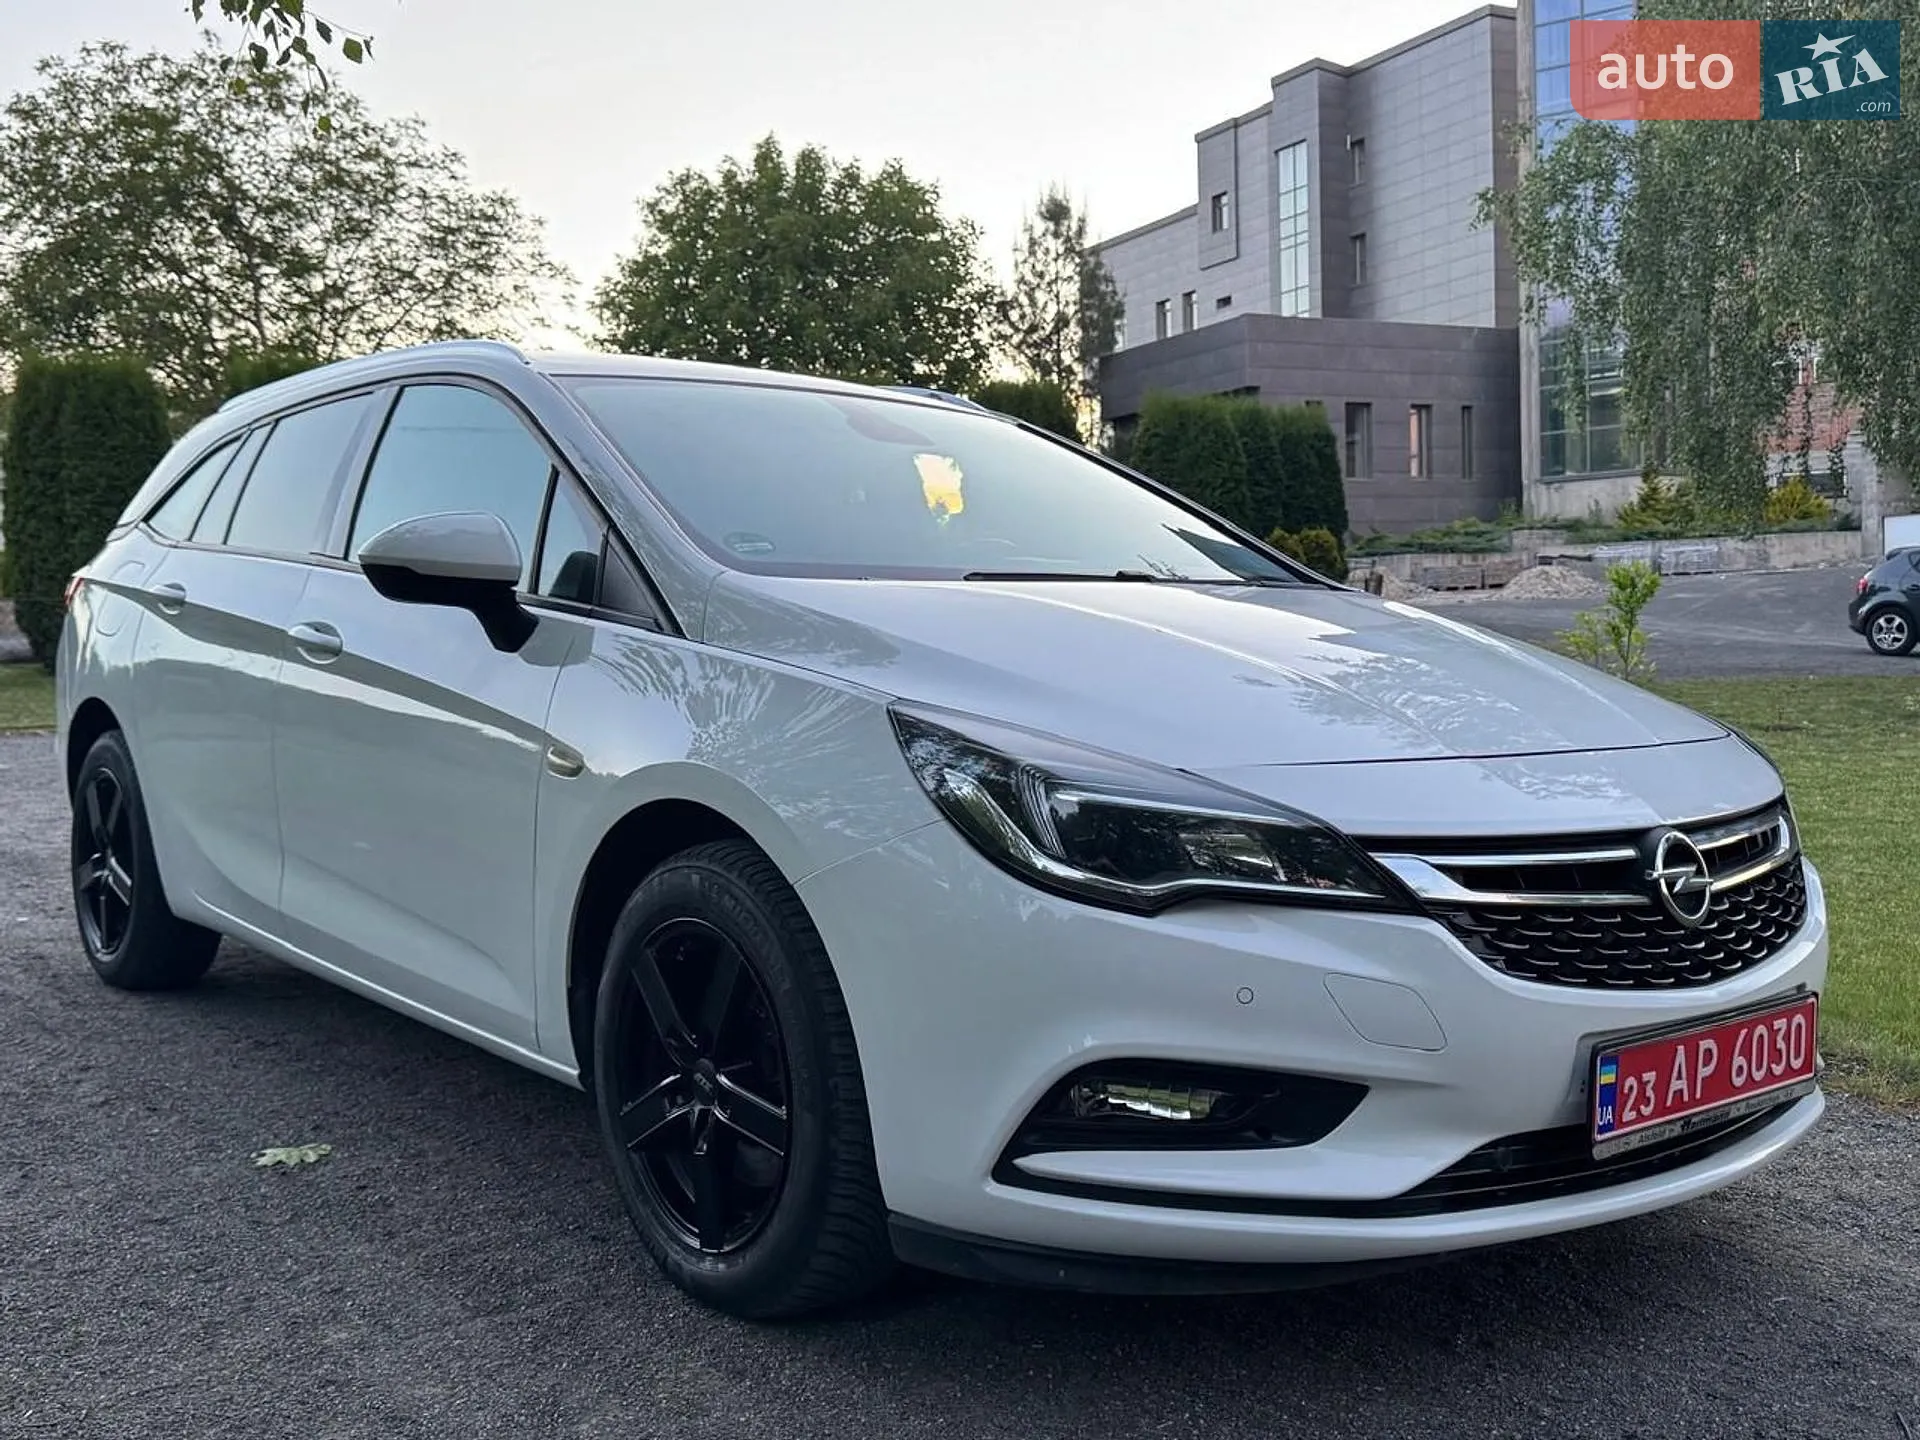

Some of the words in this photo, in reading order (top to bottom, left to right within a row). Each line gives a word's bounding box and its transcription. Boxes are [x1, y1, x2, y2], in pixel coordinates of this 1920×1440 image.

[1622, 1071, 1657, 1122] 23
[1666, 1039, 1719, 1107] AP
[1731, 1014, 1806, 1088] 6030
[1597, 1105, 1613, 1126] UA
